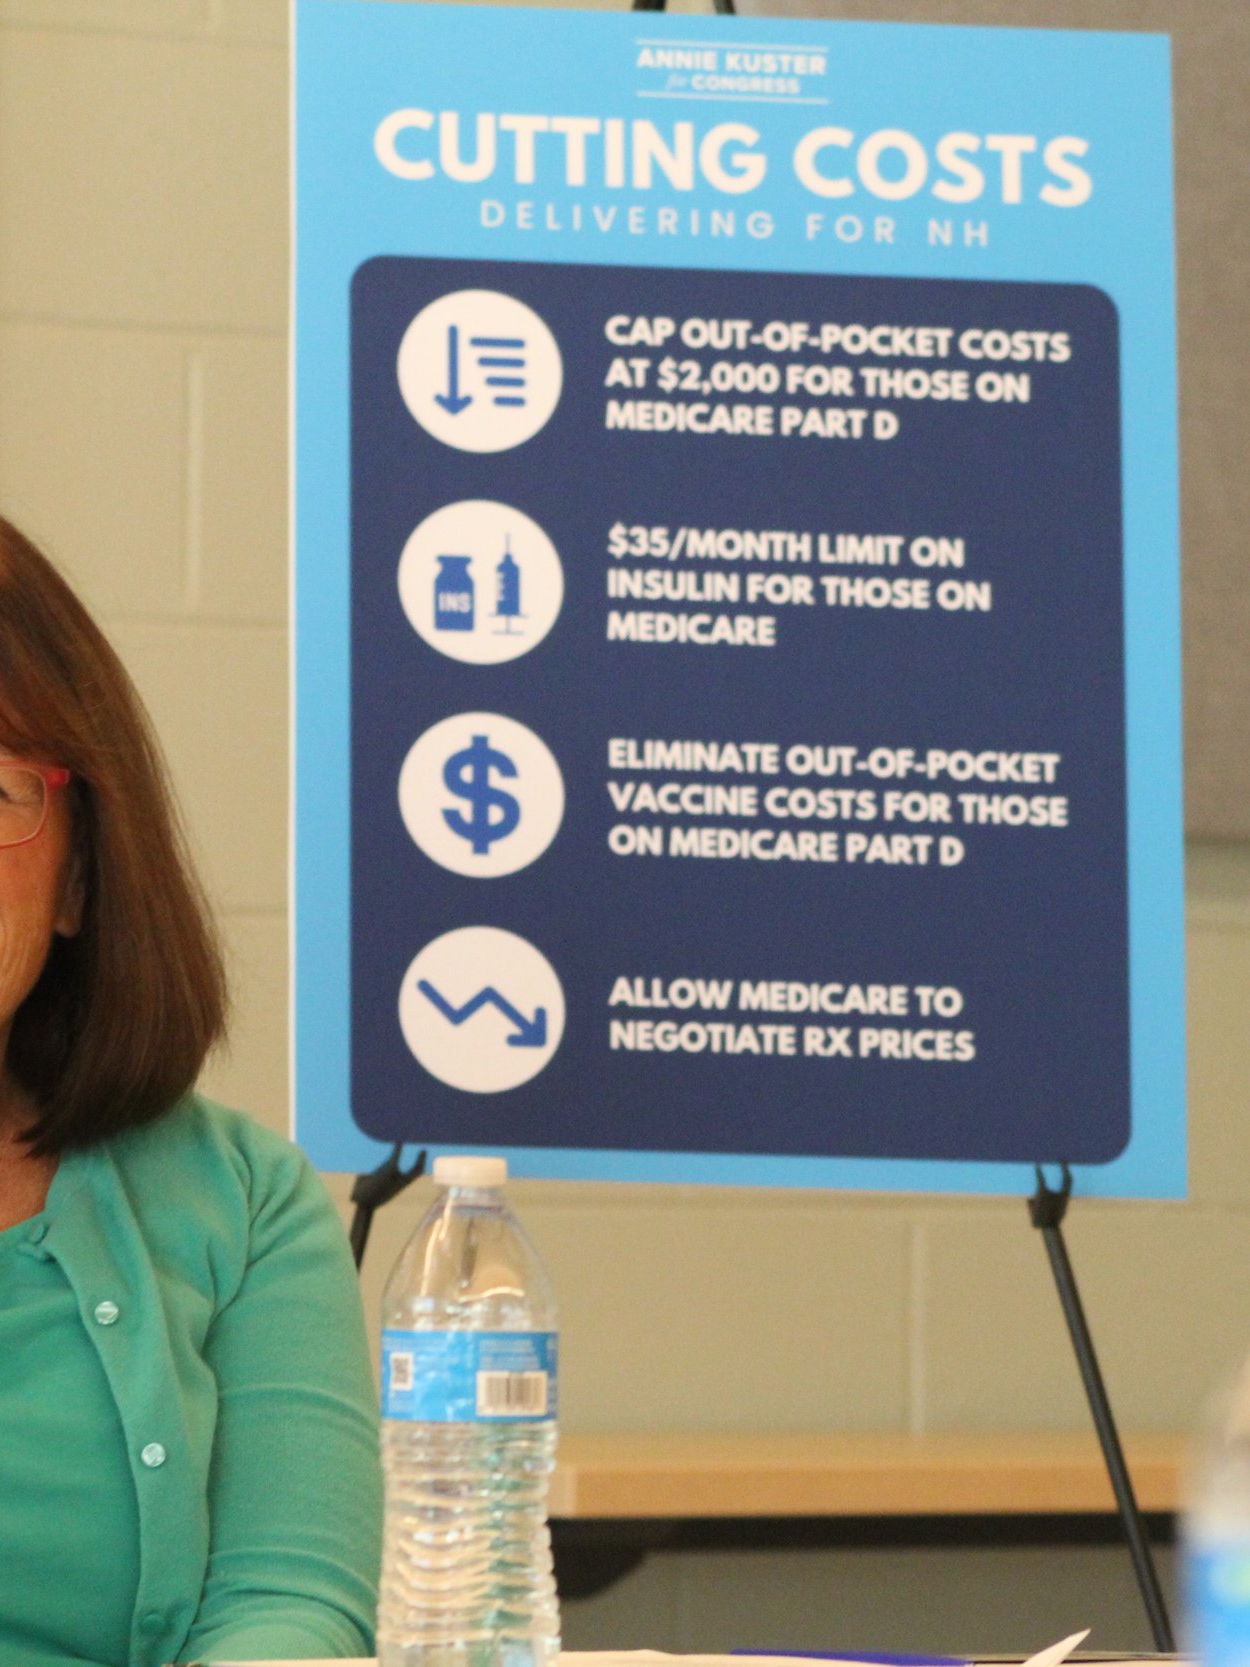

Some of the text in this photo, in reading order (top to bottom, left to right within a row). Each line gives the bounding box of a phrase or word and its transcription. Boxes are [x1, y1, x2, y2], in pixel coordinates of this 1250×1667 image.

[637, 48, 827, 75] ANNIE KUSTER
[691, 74, 800, 94] CONGRESS
[373, 107, 1093, 207] CUTTING COSTS
[480, 199, 988, 246] DELIVERING FOR NH
[605, 315, 1071, 362] CAP OUT-OF-POCKET COSTS
[605, 356, 1030, 403] AT $2,000 FOR THOSE ON
[605, 399, 899, 440] MEDICARE PART D
[608, 522, 965, 568] $35/MONTH LIMIT ON
[438, 592, 471, 613] INS
[607, 568, 991, 611] INSULIN FOR THOSE ON
[606, 611, 776, 646] MEDICARE
[608, 738, 1060, 783] ELIMINATE OUT-OF-POCKET
[607, 781, 1068, 827] VACCINE COSTS FOR THOSE
[608, 824, 965, 866] ON MEDICARE PART D
[608, 976, 963, 1018] ALLOW MEDICARE TO
[610, 1020, 976, 1062] NEGOTIATE RX PRICES
